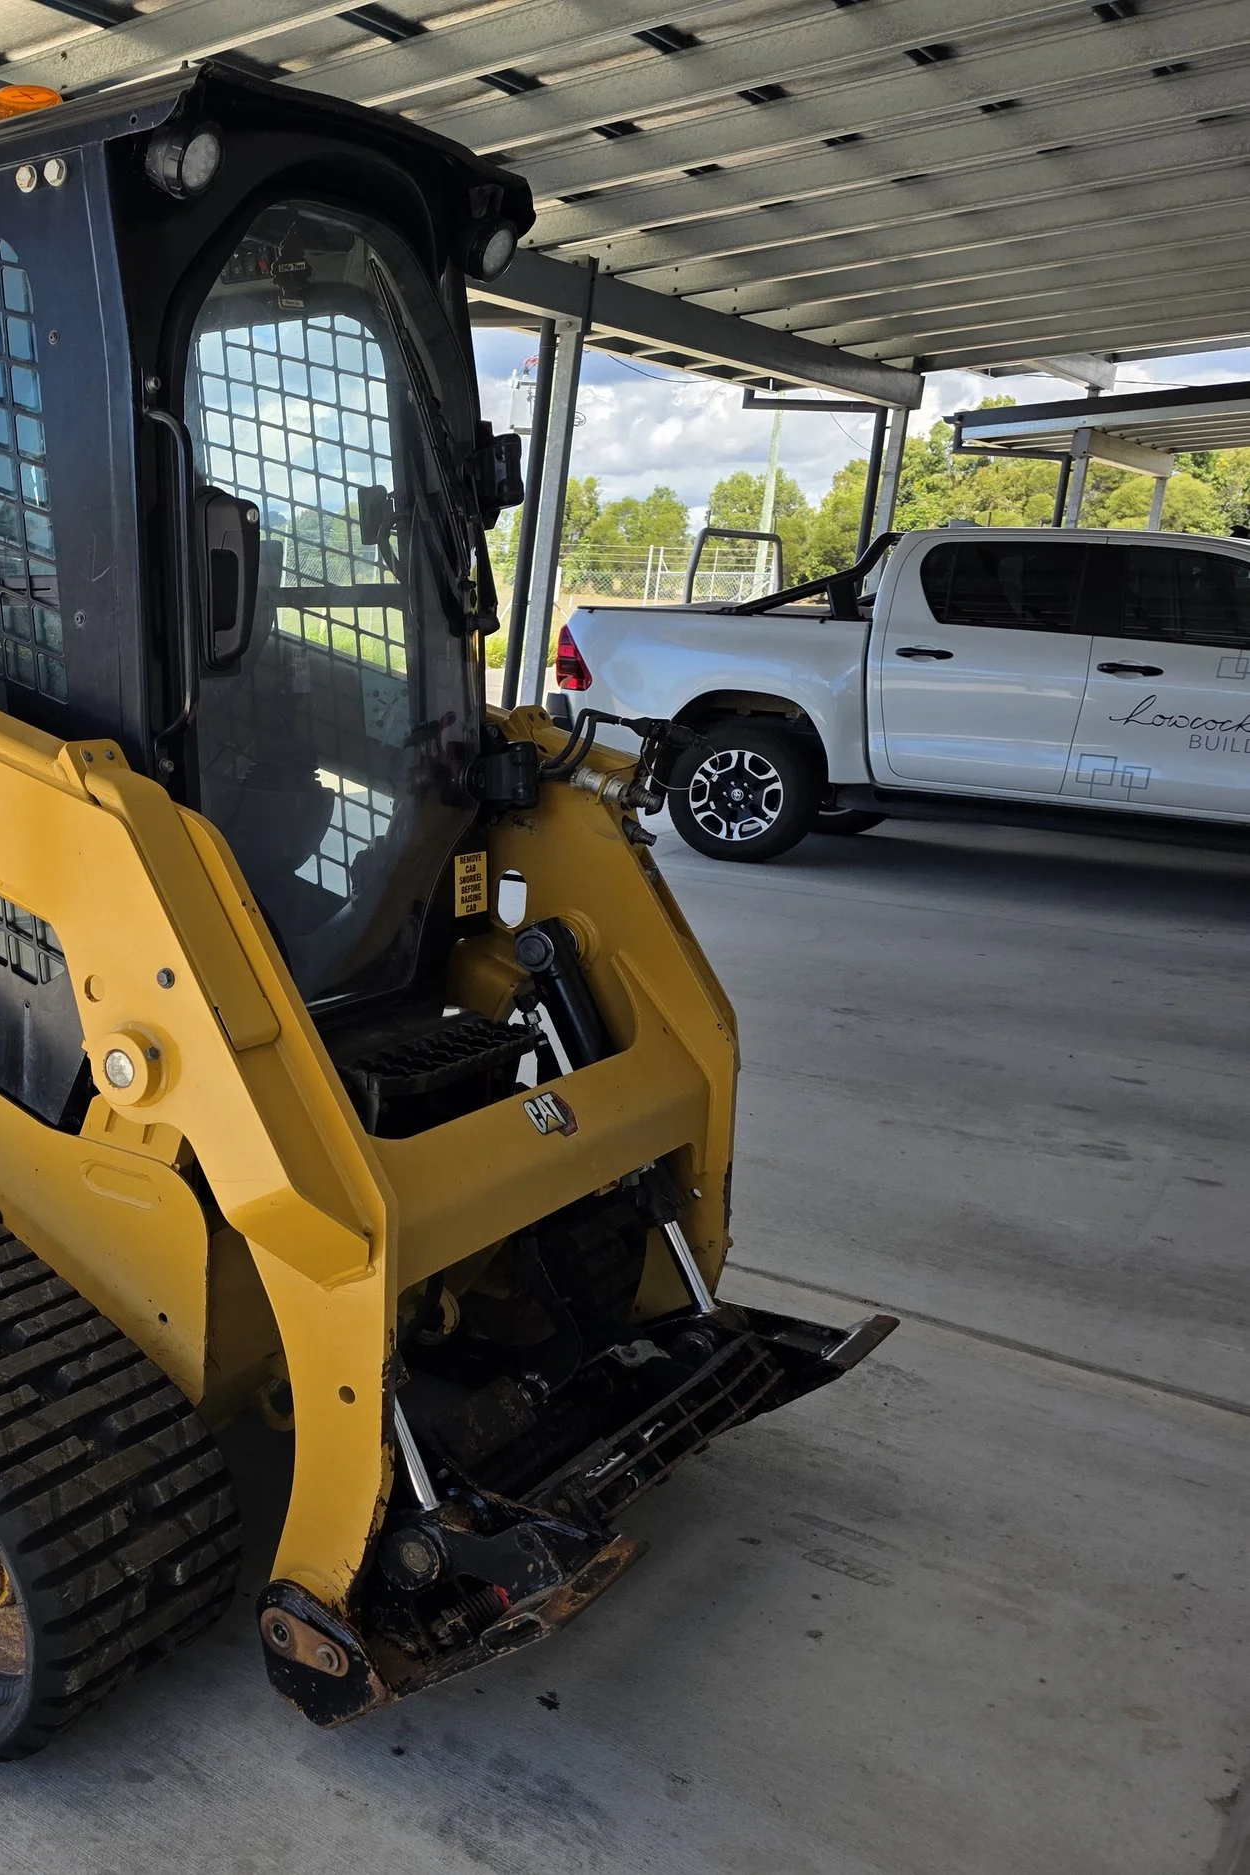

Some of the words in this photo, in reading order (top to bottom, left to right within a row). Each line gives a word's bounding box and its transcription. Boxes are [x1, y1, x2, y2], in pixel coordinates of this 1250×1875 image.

[459, 853, 482, 865] REMOVE
[465, 864, 476, 874] CAB
[459, 873, 483, 885] SNORKEL
[461, 883, 481, 895] BEFORE
[460, 893, 482, 905] RAISING
[465, 904, 477, 913] CAB
[523, 1092, 567, 1134] CAT
